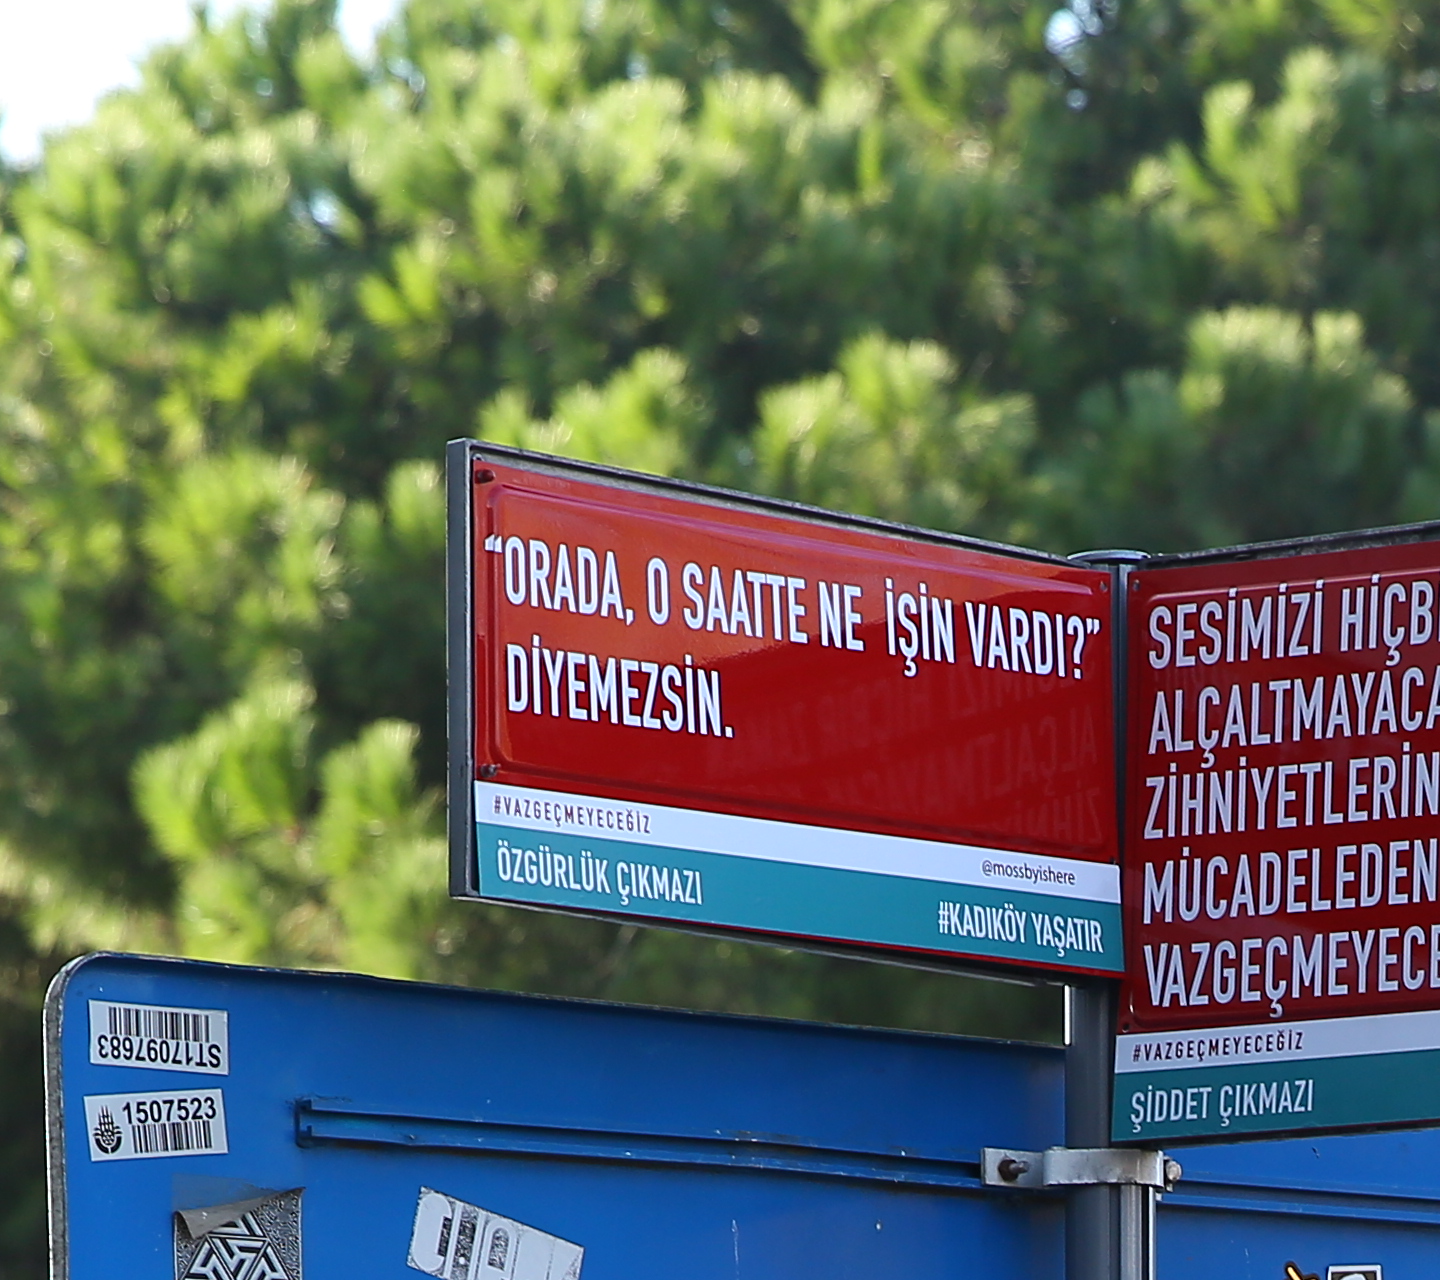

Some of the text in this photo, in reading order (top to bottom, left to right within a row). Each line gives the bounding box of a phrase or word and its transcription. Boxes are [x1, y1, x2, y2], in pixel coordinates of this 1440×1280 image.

[484, 534, 1100, 680] “ORADA, O SAATTE NE İŞİN VARDI?”
[1148, 578, 1324, 670] SESİMİZİ
[506, 634, 734, 738] DİYEMEZSİN.
[494, 795, 651, 834] #VAZGEÇMEYECEĞİZ
[497, 839, 703, 906] ÖZGÜRLÜK ÇIKMAZI
[982, 860, 1076, 886] @mossbyishere
[1142, 838, 1438, 925] MÜCADELEDEN
[938, 901, 1104, 957] #KADIKÖY YAŞATIR
[98, 1034, 222, 1068] ST17097683
[1133, 1030, 1304, 1062] #VAZGEÇMEYECEĞİZ
[122, 1096, 217, 1125] 1507523
[1131, 1079, 1314, 1133] ŞİDDET ÇIKMAZI
